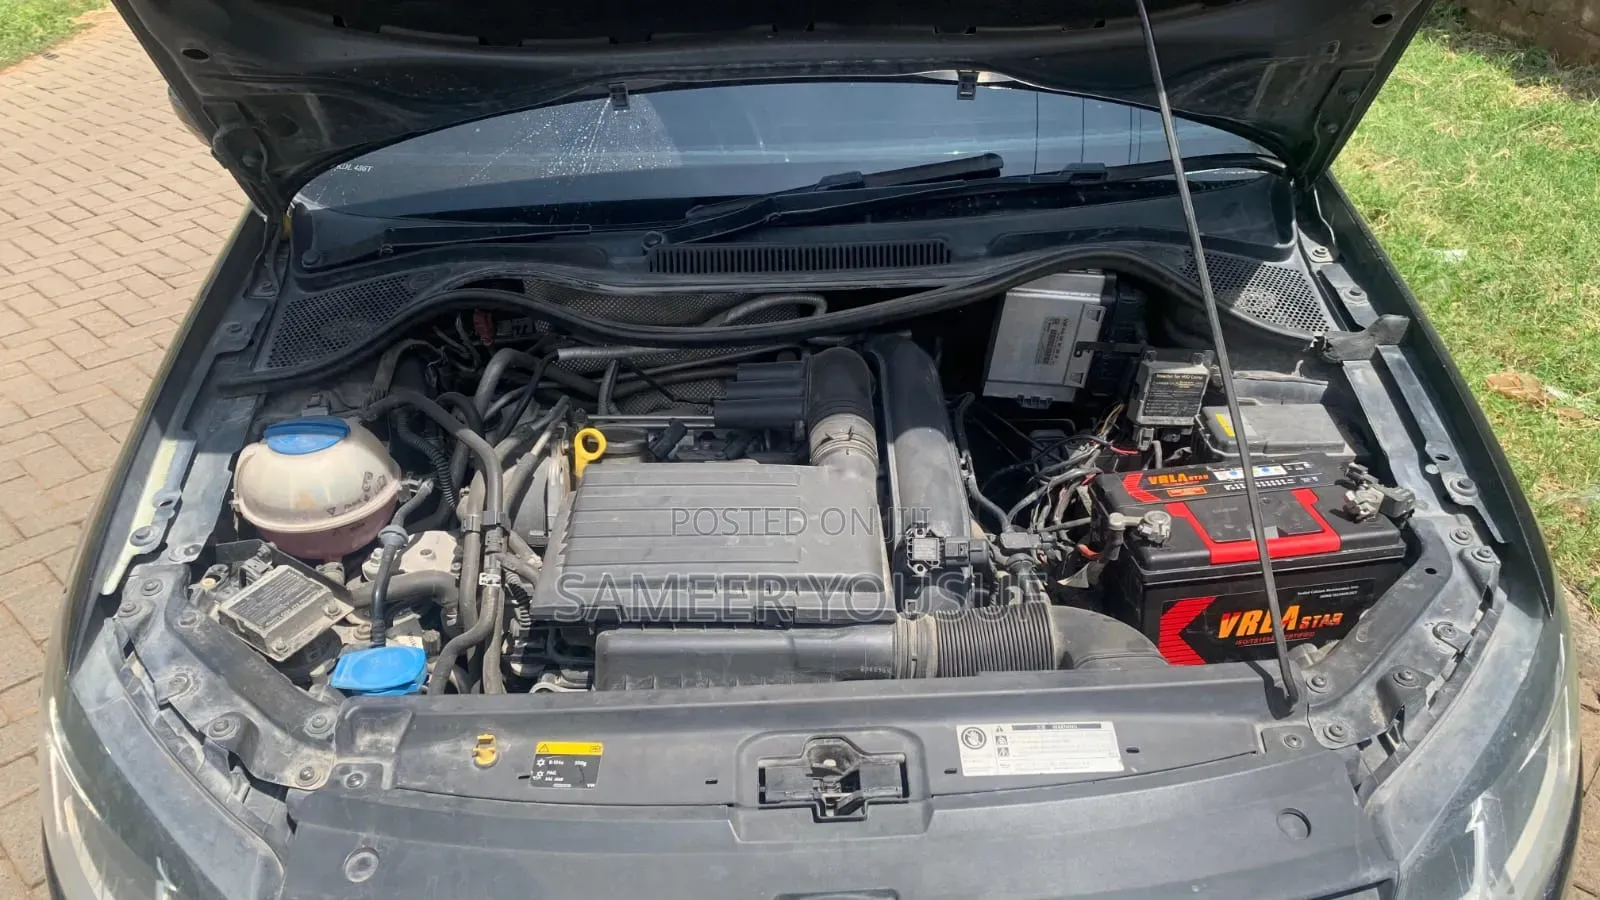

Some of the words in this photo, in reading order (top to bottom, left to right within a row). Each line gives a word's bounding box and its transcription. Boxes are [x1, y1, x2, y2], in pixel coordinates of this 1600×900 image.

[1148, 472, 1189, 485] VRLA
[1218, 605, 1301, 639] VRLA
[1299, 612, 1344, 630] STAR
